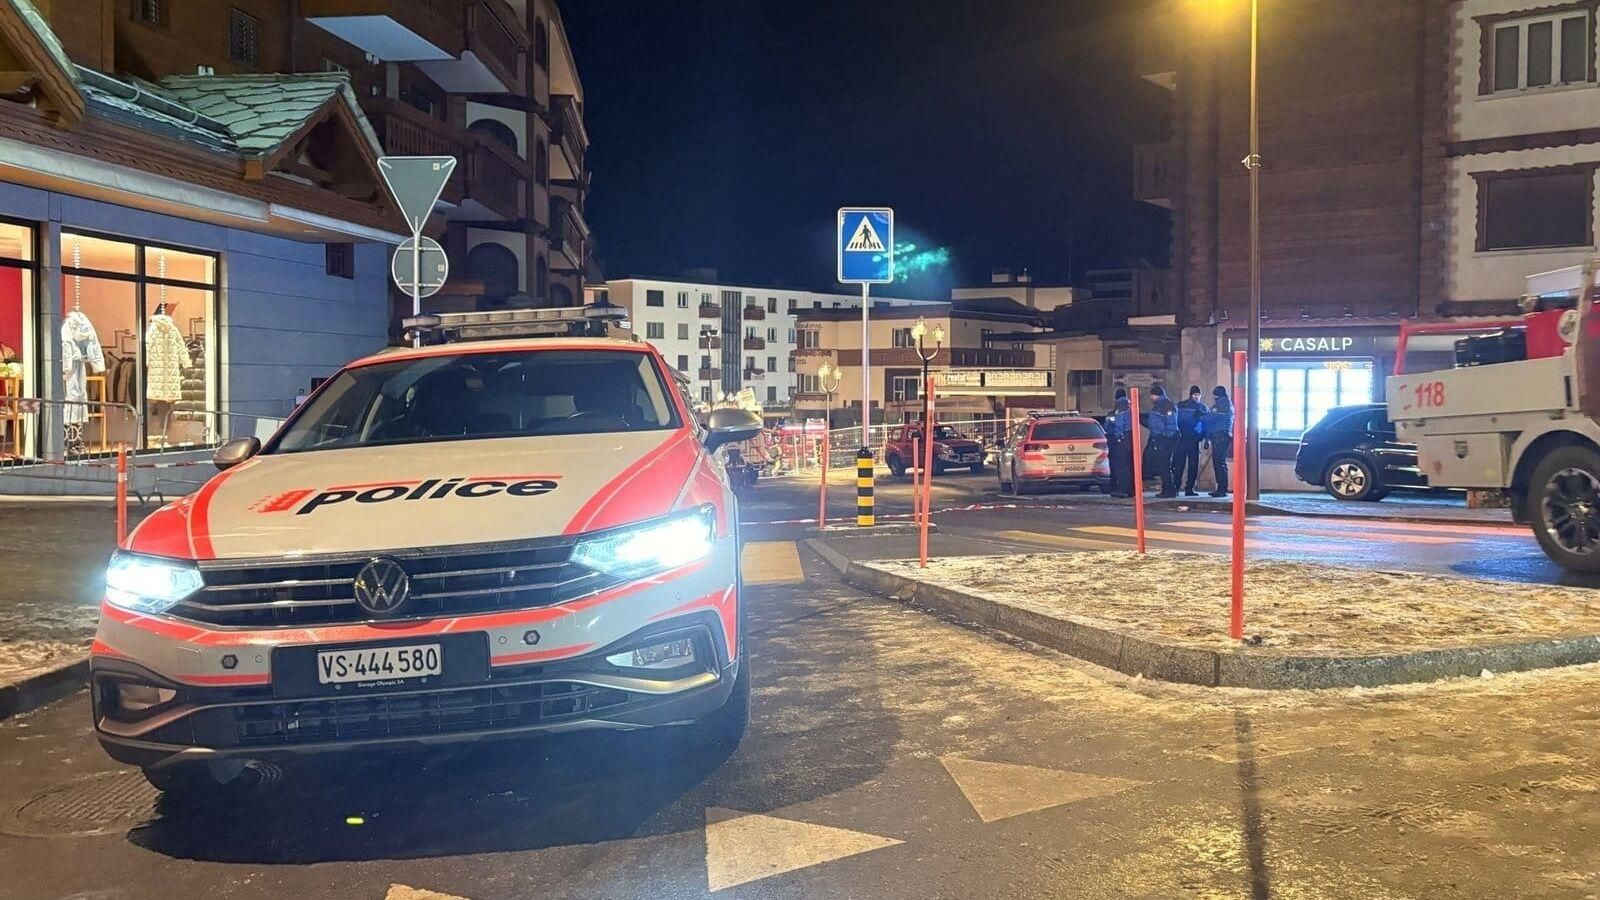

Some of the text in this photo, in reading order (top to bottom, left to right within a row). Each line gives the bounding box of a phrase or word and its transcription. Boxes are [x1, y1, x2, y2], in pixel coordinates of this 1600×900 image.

[1280, 337, 1353, 351] CASALP
[1415, 381, 1445, 409] 118
[295, 478, 559, 515] police
